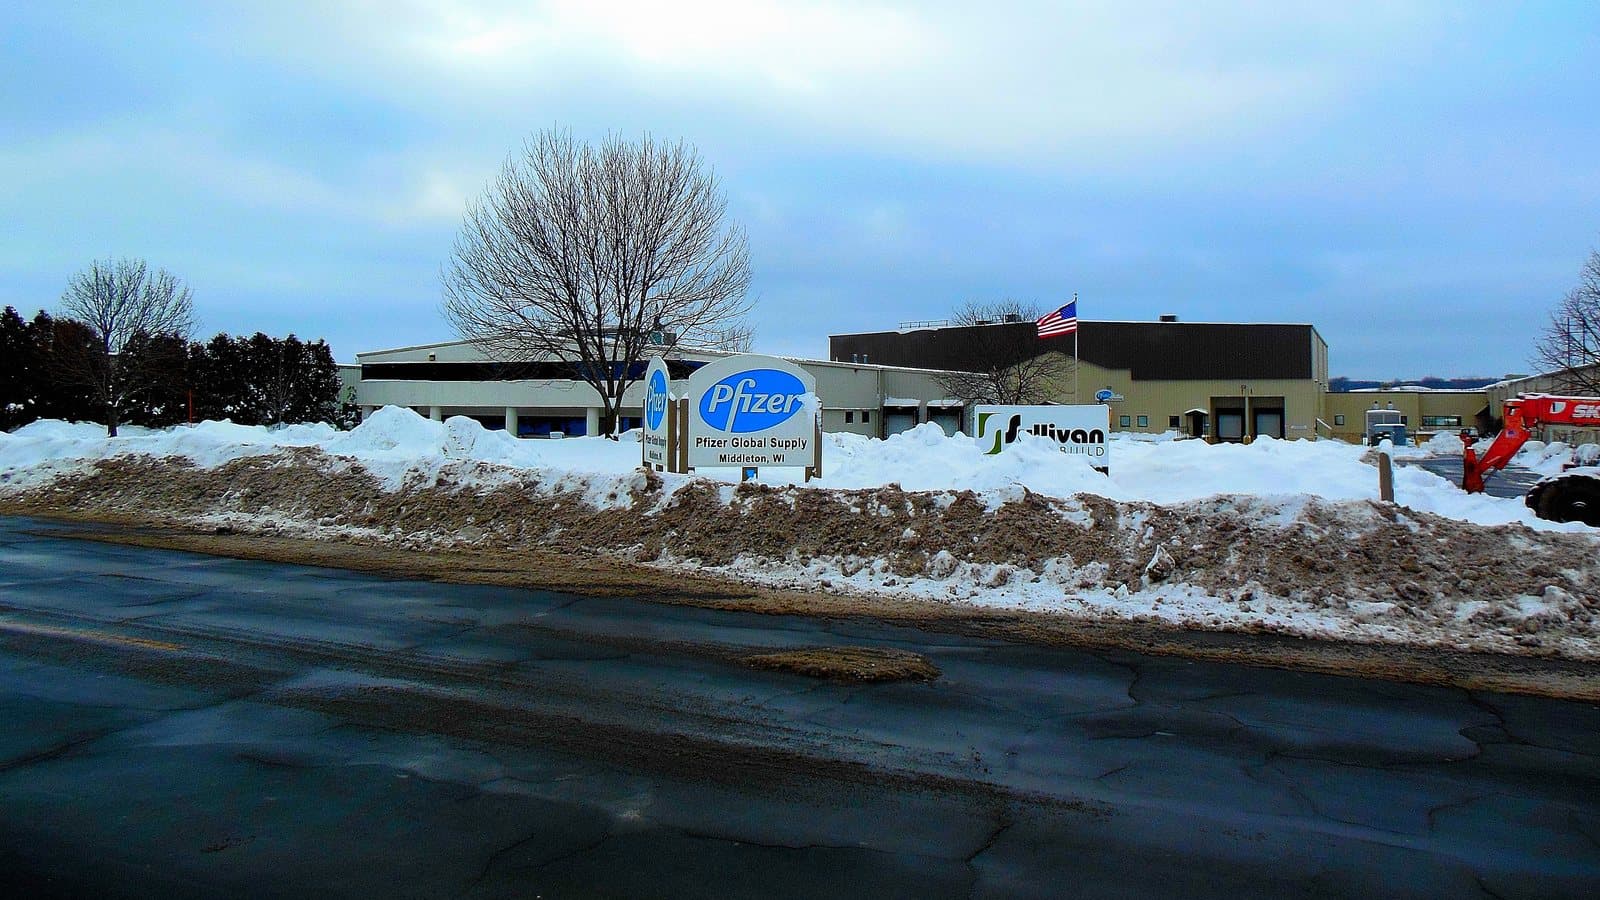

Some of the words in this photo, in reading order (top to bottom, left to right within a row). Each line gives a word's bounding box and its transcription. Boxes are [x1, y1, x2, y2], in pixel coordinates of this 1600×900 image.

[708, 379, 803, 433] Pfizer
[1005, 414, 1104, 443] Sllivan
[695, 437, 728, 448] Pfizer
[731, 437, 766, 448] Global
[770, 437, 807, 449] Supply
[719, 454, 769, 464] Middleton,
[773, 454, 785, 463] WI
